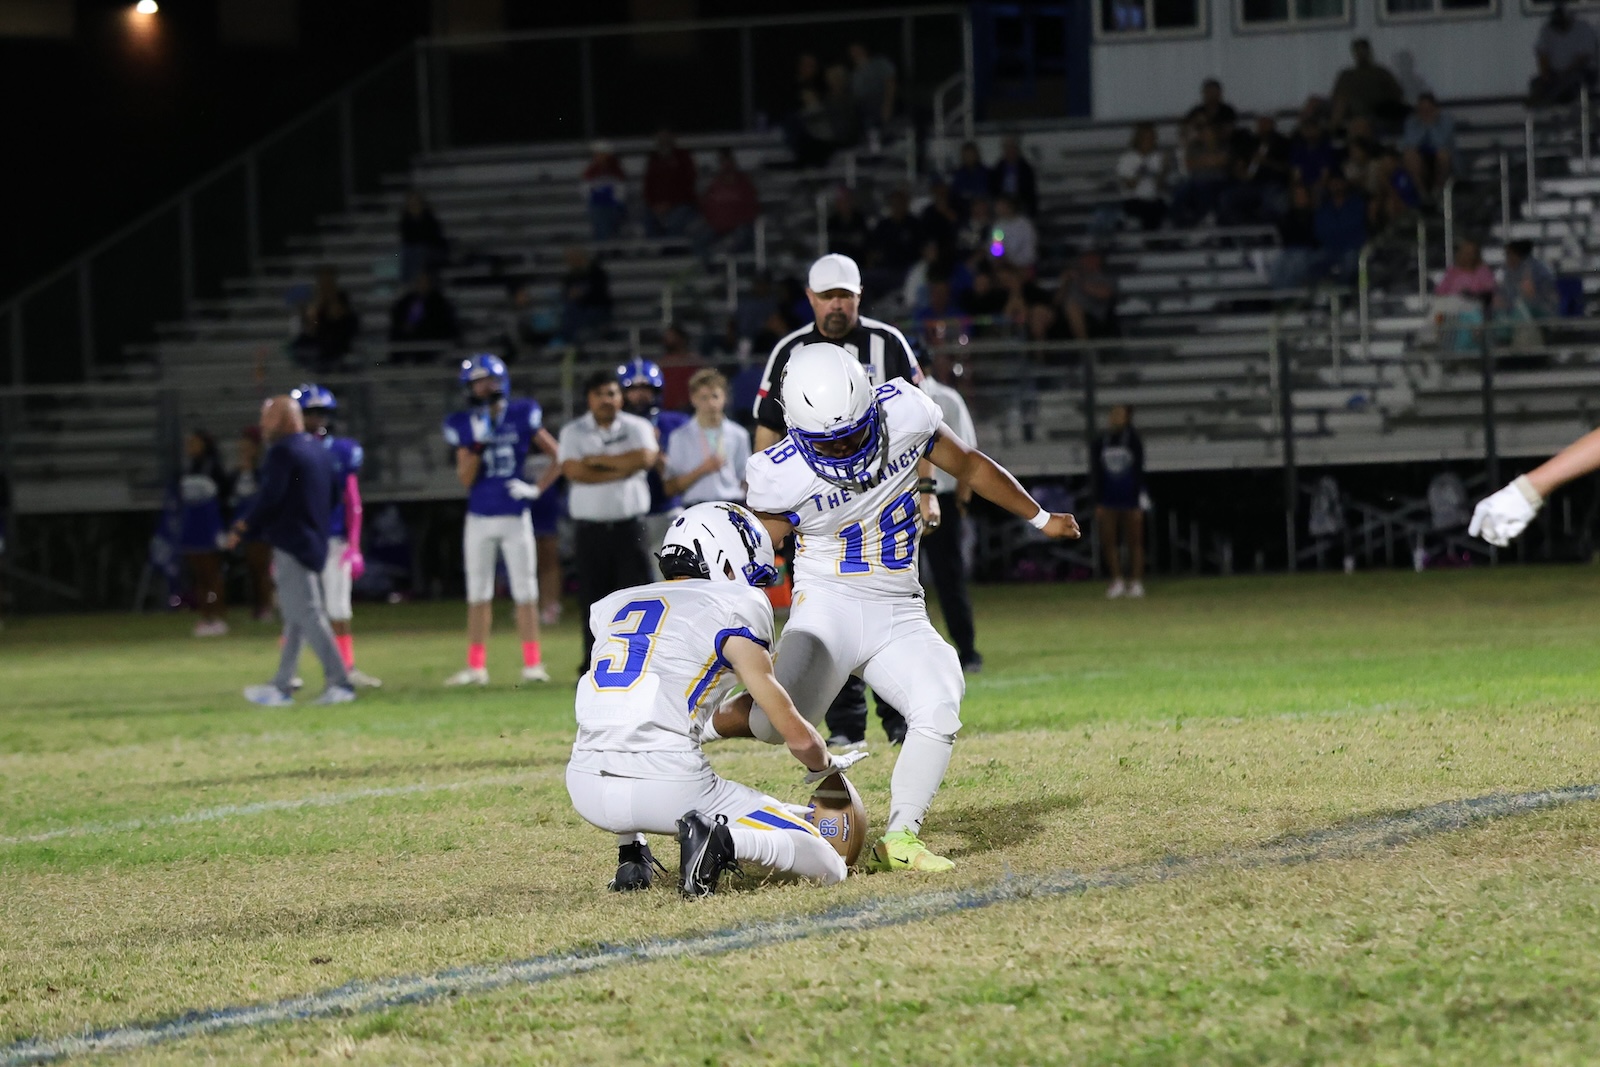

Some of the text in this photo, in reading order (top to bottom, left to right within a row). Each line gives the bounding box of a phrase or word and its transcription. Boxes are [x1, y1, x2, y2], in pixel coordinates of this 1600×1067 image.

[811, 445, 919, 511] THE RANCH
[834, 487, 920, 577] 18
[590, 596, 670, 692] 3
